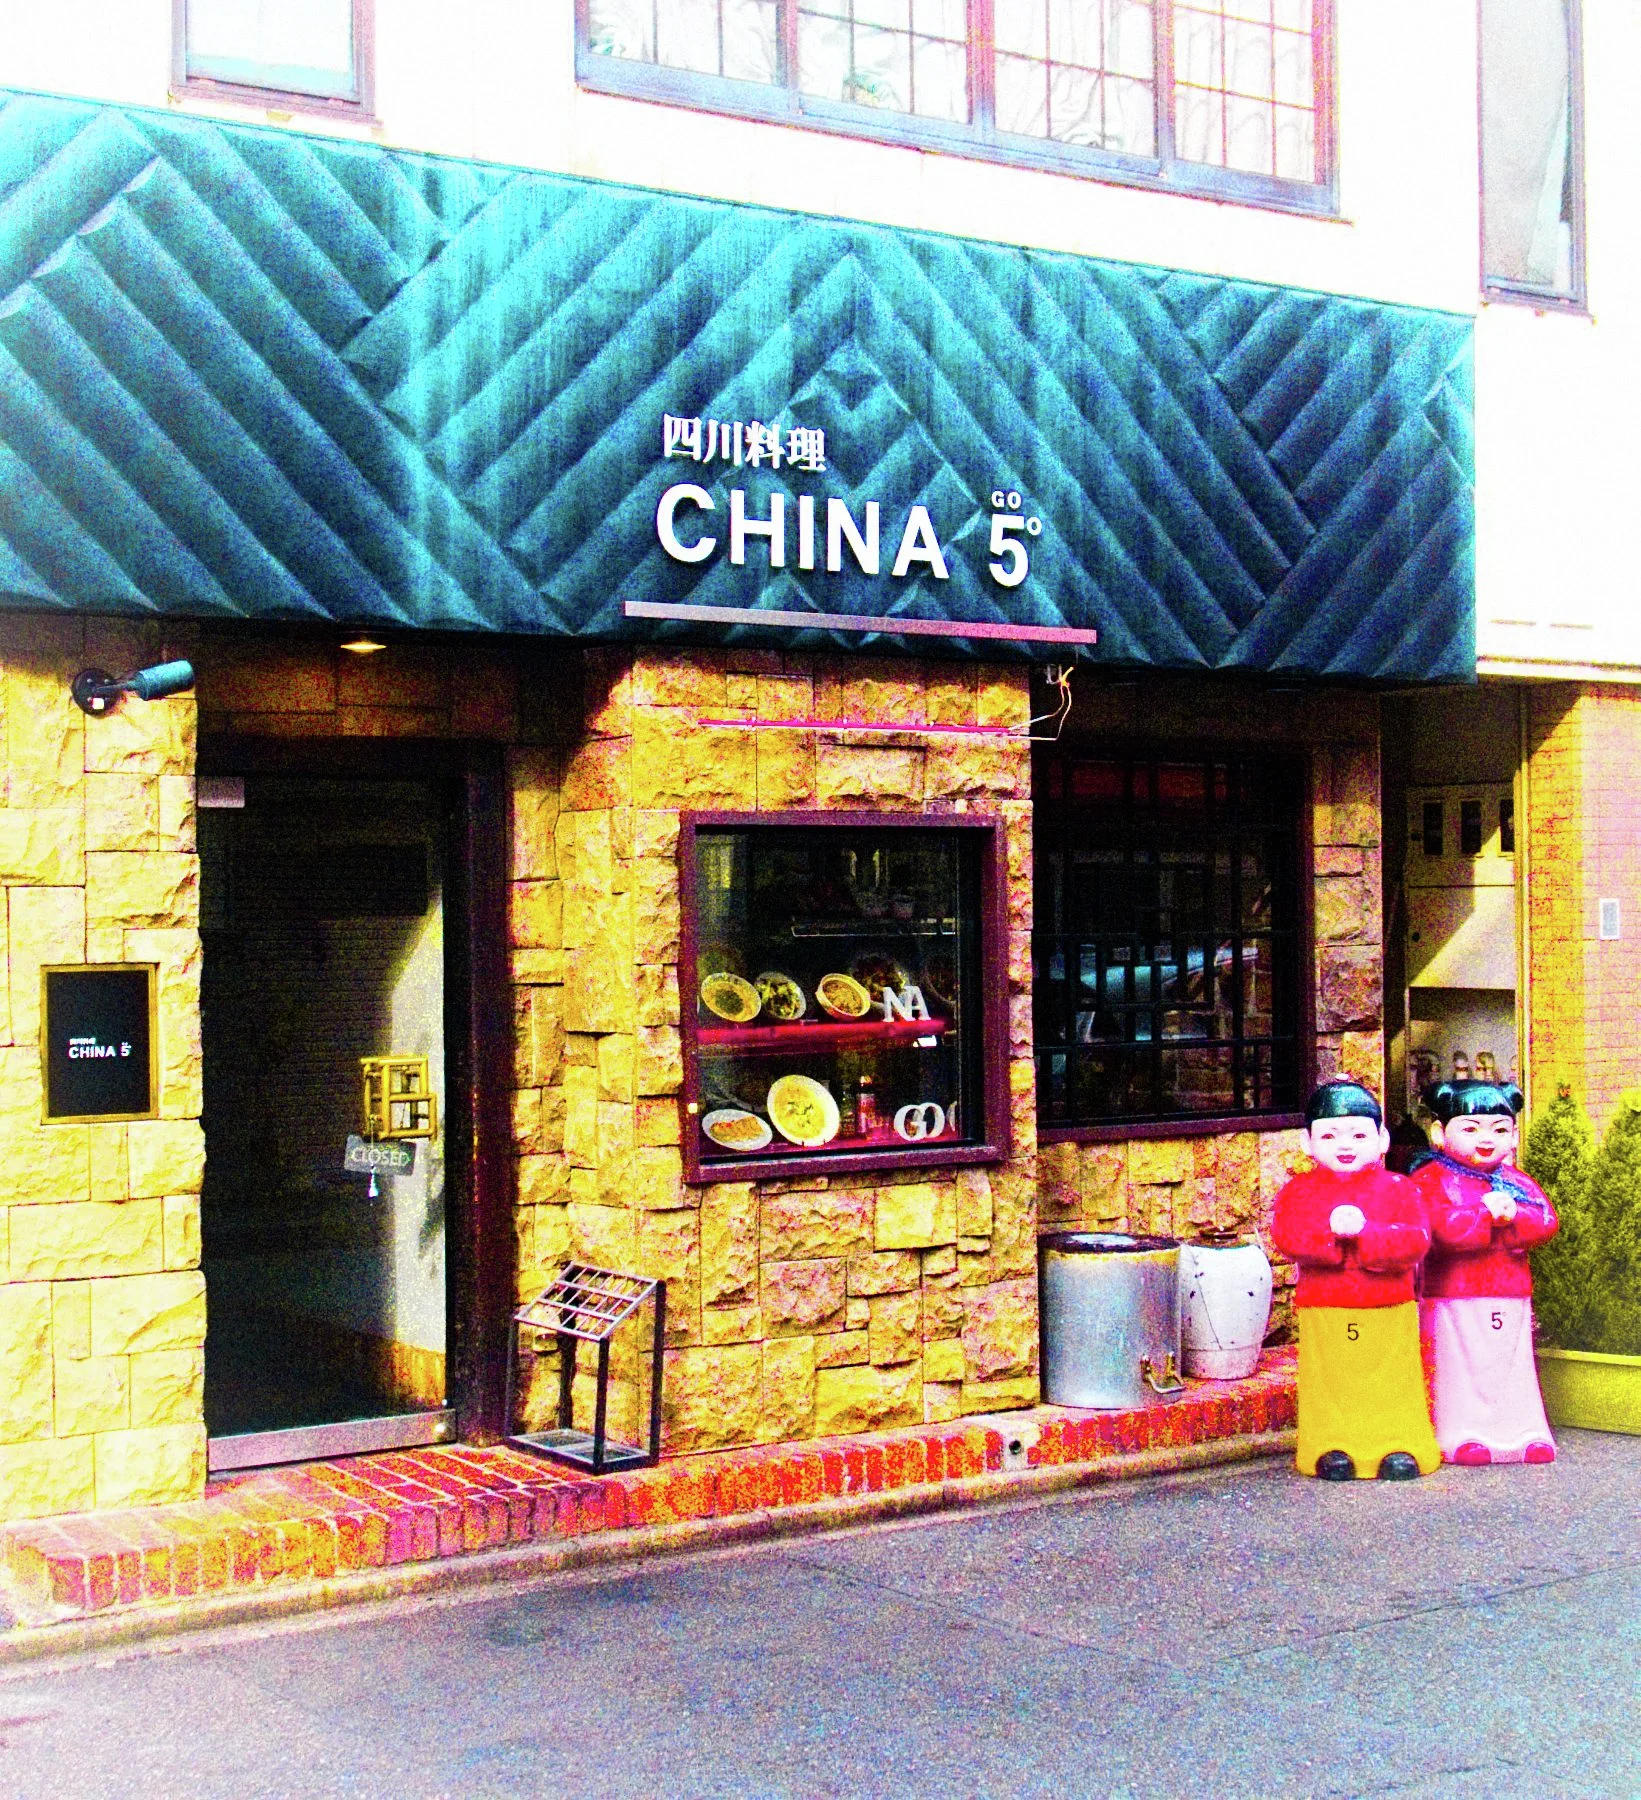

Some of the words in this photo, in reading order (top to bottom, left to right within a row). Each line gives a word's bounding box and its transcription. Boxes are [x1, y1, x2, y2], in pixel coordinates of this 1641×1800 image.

[663, 413, 826, 471] 四川料理
[991, 490, 1021, 509] GO
[656, 483, 949, 579] CHINA
[69, 1046, 116, 1058] CHINA
[351, 1146, 410, 1167] CLOSED
